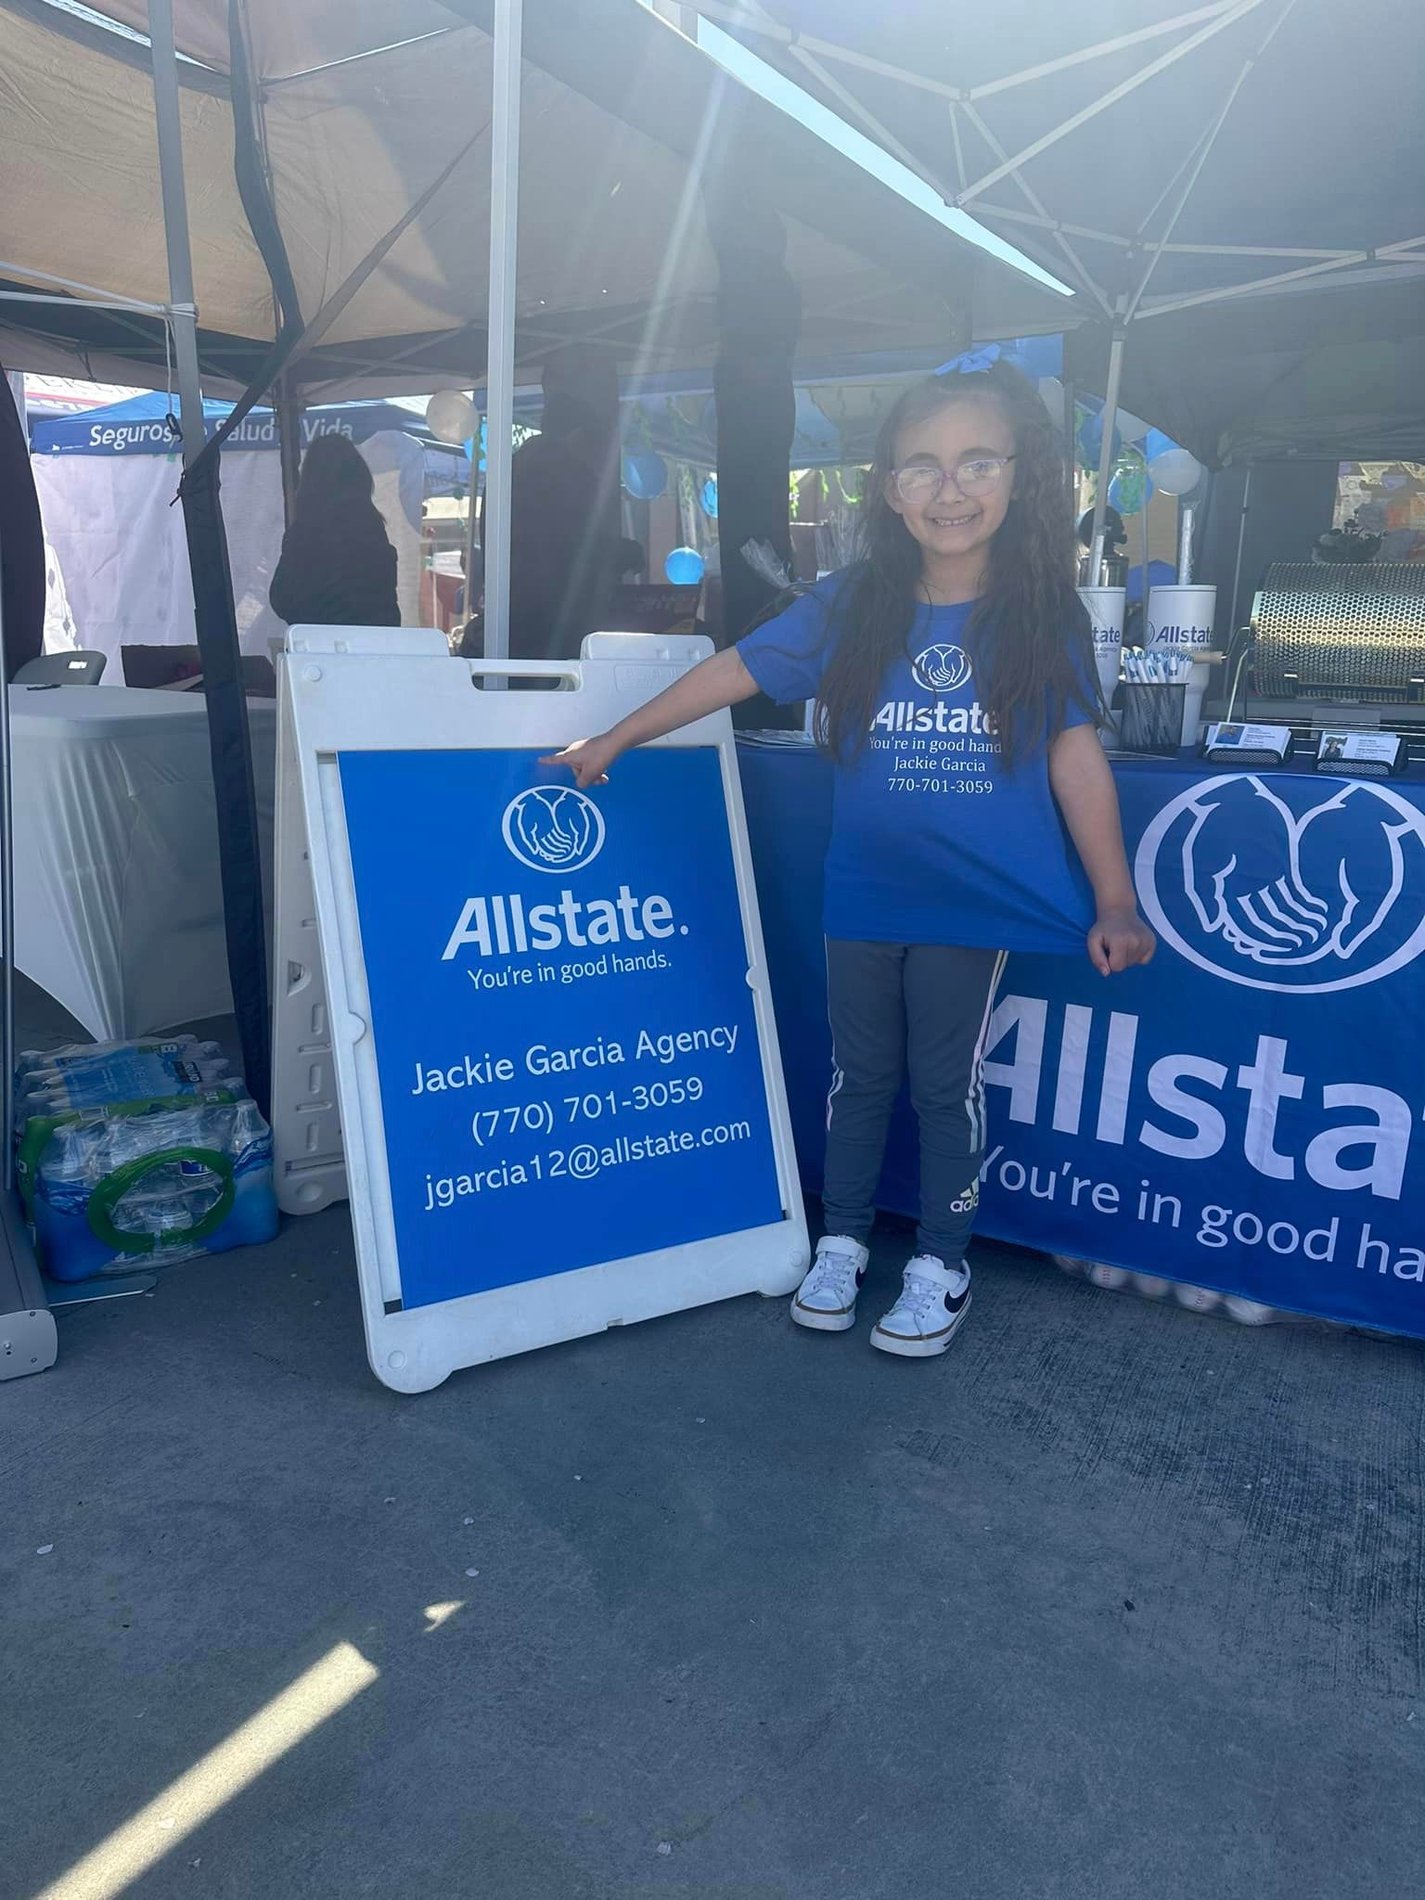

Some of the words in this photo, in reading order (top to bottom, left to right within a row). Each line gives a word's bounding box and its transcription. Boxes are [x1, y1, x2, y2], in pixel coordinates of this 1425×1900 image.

[89, 423, 173, 450] Seguros
[302, 417, 354, 442] Vida
[869, 736, 908, 750] You're
[912, 737, 926, 750] in
[929, 739, 965, 753] good
[969, 738, 1002, 753] hand
[893, 756, 937, 772] Jackie
[941, 757, 986, 772] Garcia
[888, 777, 993, 793] 770-701-3059
[441, 885, 689, 960] Allstate.
[467, 965, 533, 990] You're
[538, 963, 556, 982] in
[560, 956, 608, 984] good
[611, 949, 672, 973] hands.
[411, 1053, 515, 1095] Jackie
[525, 1036, 626, 1076] Garcia
[635, 1024, 739, 1064] Agency
[471, 1100, 554, 1147] (770)
[563, 1076, 704, 1123] 701-3059
[982, 994, 1425, 1200] Allsta
[424, 1119, 752, 1211] jgarcia12@allstate.com
[979, 1145, 1120, 1214] You're
[1137, 1179, 1182, 1228] in
[1196, 1204, 1340, 1263] good
